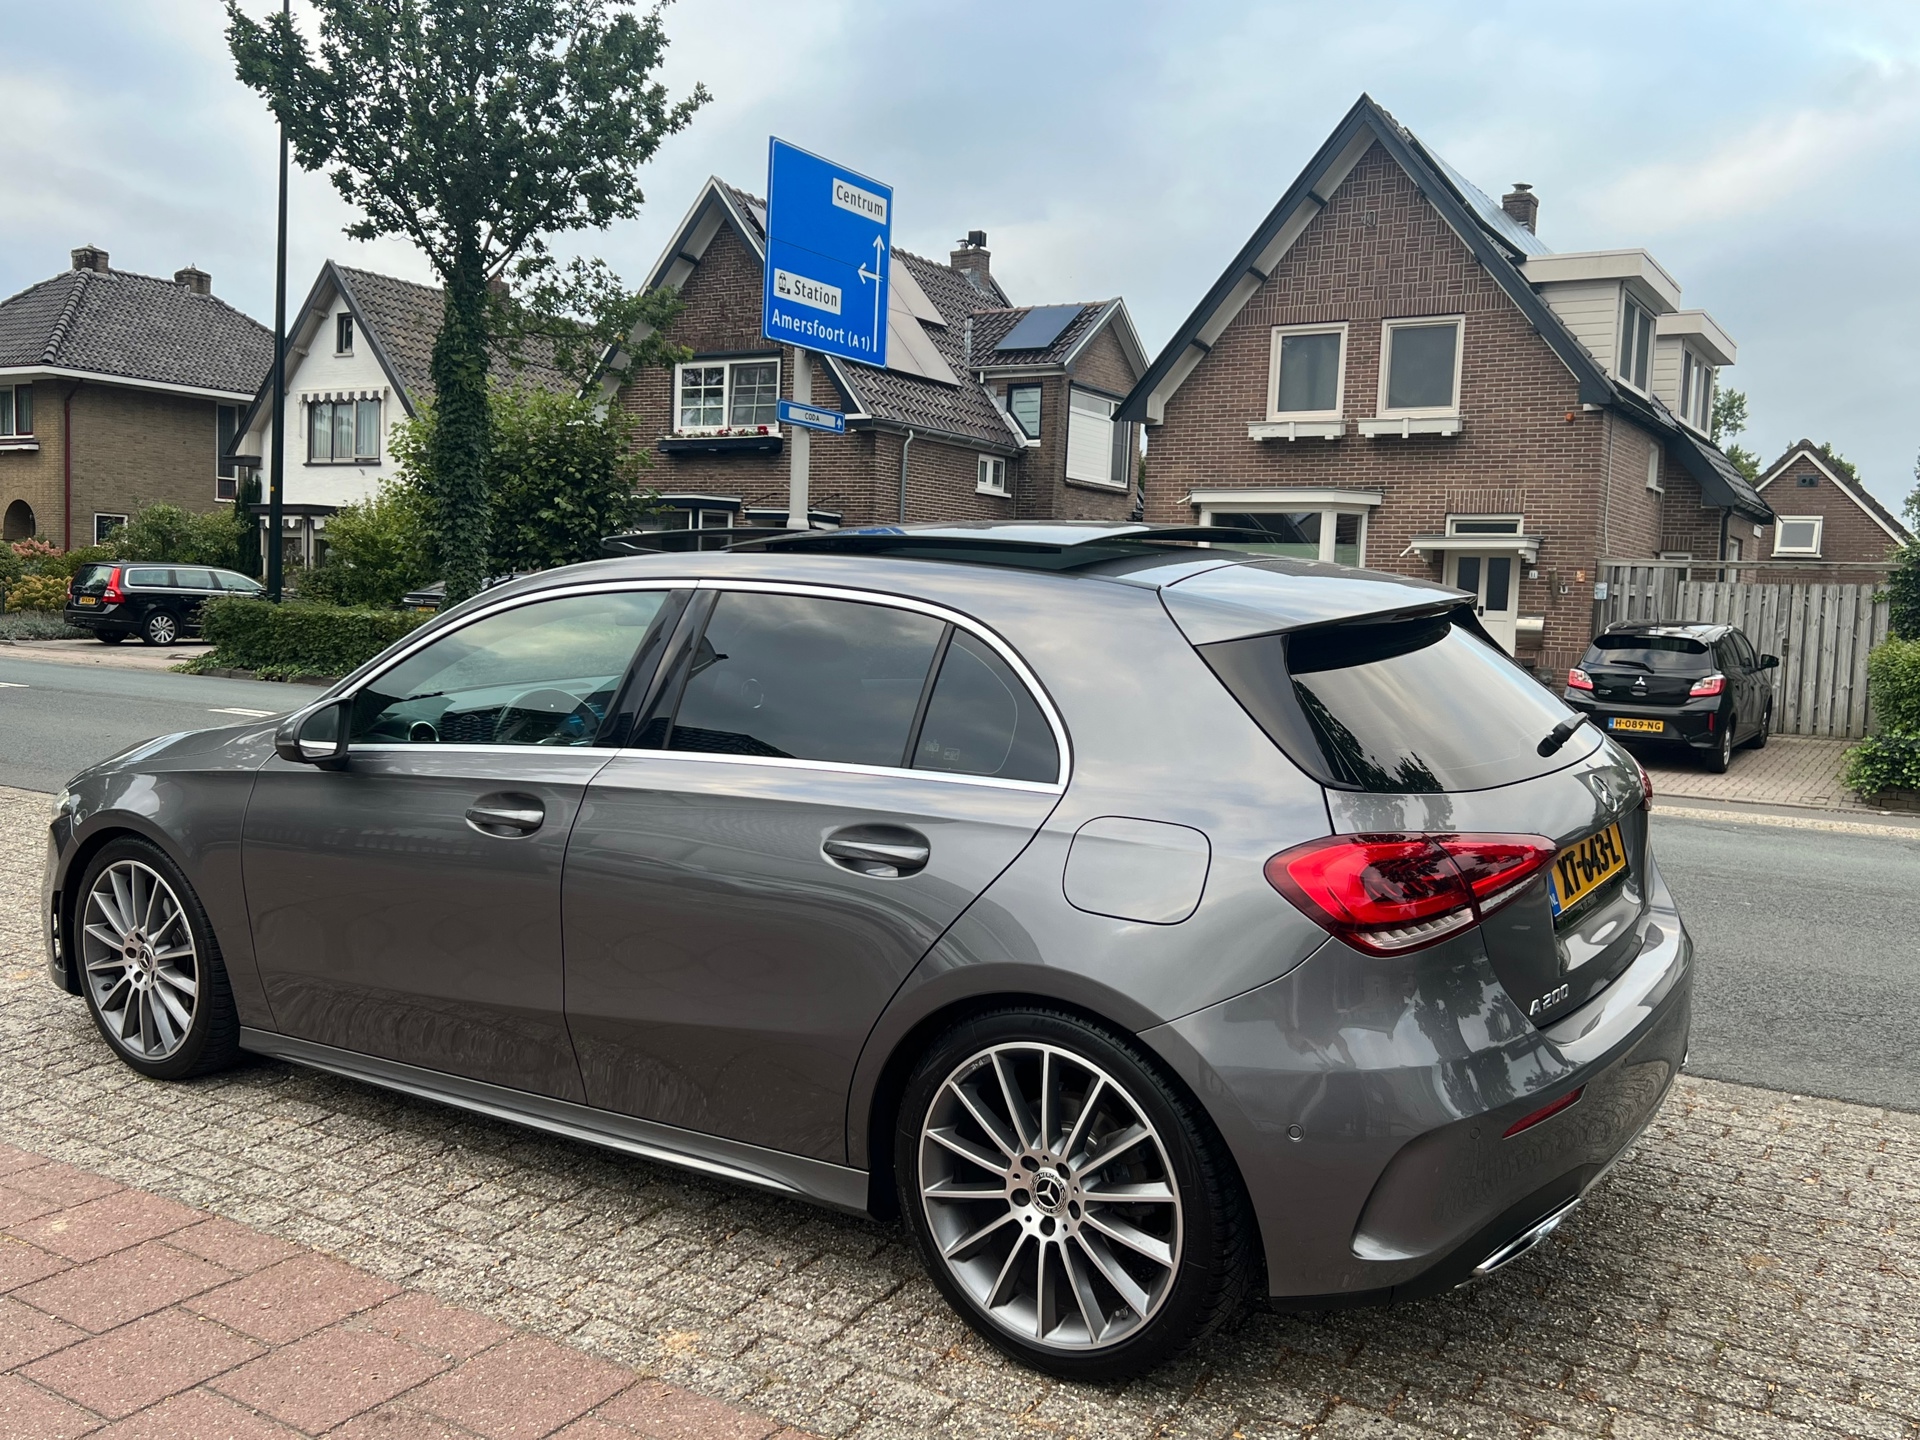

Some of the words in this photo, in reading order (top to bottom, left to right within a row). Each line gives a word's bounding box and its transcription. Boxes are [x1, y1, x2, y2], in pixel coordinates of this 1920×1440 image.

[836, 184, 883, 217] Centrum
[794, 280, 837, 307] Station
[771, 308, 845, 344] Amersfoort
[804, 412, 820, 422] CODA
[1614, 719, 1662, 731] H-089-NG
[1556, 827, 1622, 901] XT-643-L
[1529, 998, 1541, 1016] A
[1542, 983, 1569, 1010] 200
